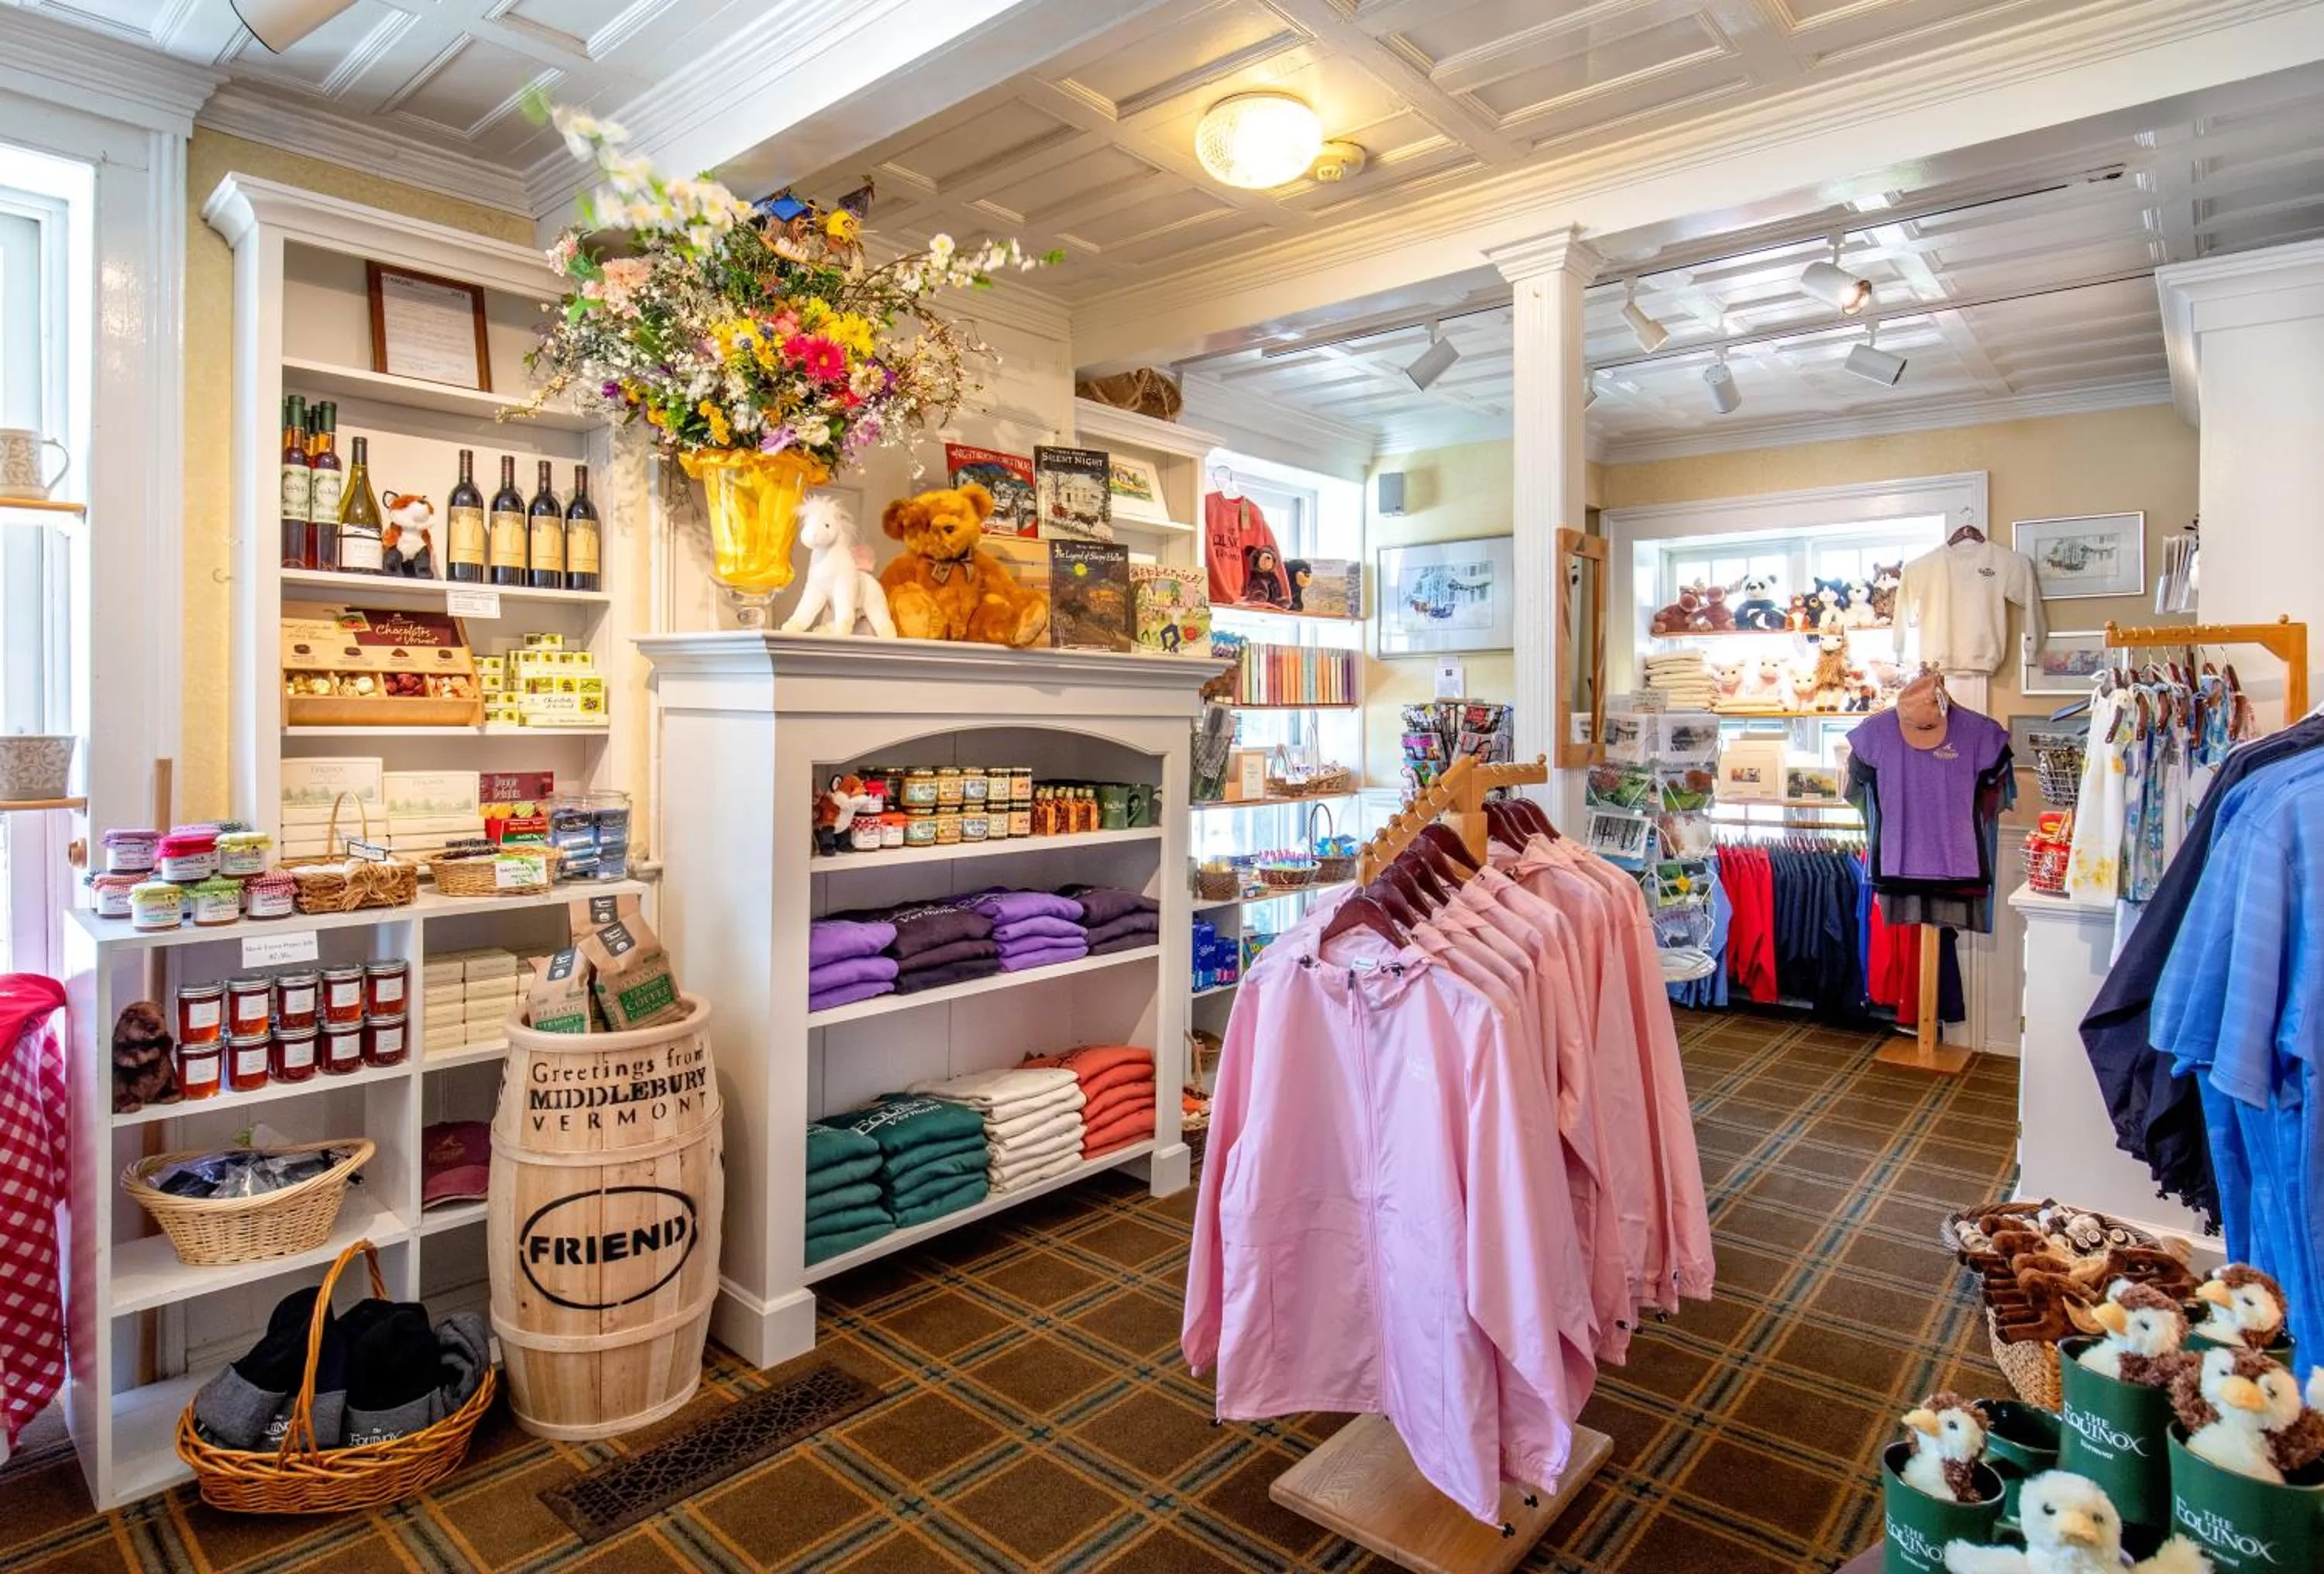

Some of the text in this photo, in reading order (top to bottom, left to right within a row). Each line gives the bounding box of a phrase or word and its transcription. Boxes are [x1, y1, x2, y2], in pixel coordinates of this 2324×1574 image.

[1041, 452, 1105, 468] SILENT NIGHT
[1065, 548, 1084, 562] Legend
[1091, 550, 1105, 565] Sleepy
[376, 622, 431, 638] Chocolates
[404, 635, 439, 645] Vermont
[626, 985, 669, 1012] COFFEE
[533, 1014, 582, 1030] VERMONT
[532, 1058, 655, 1083] Greetings
[529, 1066, 706, 1111] MIDDLEBURY
[533, 1091, 706, 1132] VERMONT
[530, 1215, 686, 1265] FRIEND
[2063, 1400, 2150, 1457] EQUINOX
[2083, 1410, 2110, 1430] THE
[1903, 1523, 1925, 1542] THE
[2175, 1493, 2283, 1565] EQUINOX
[2203, 1509, 2233, 1532] THE
[1886, 1511, 1944, 1563] EQUINO
